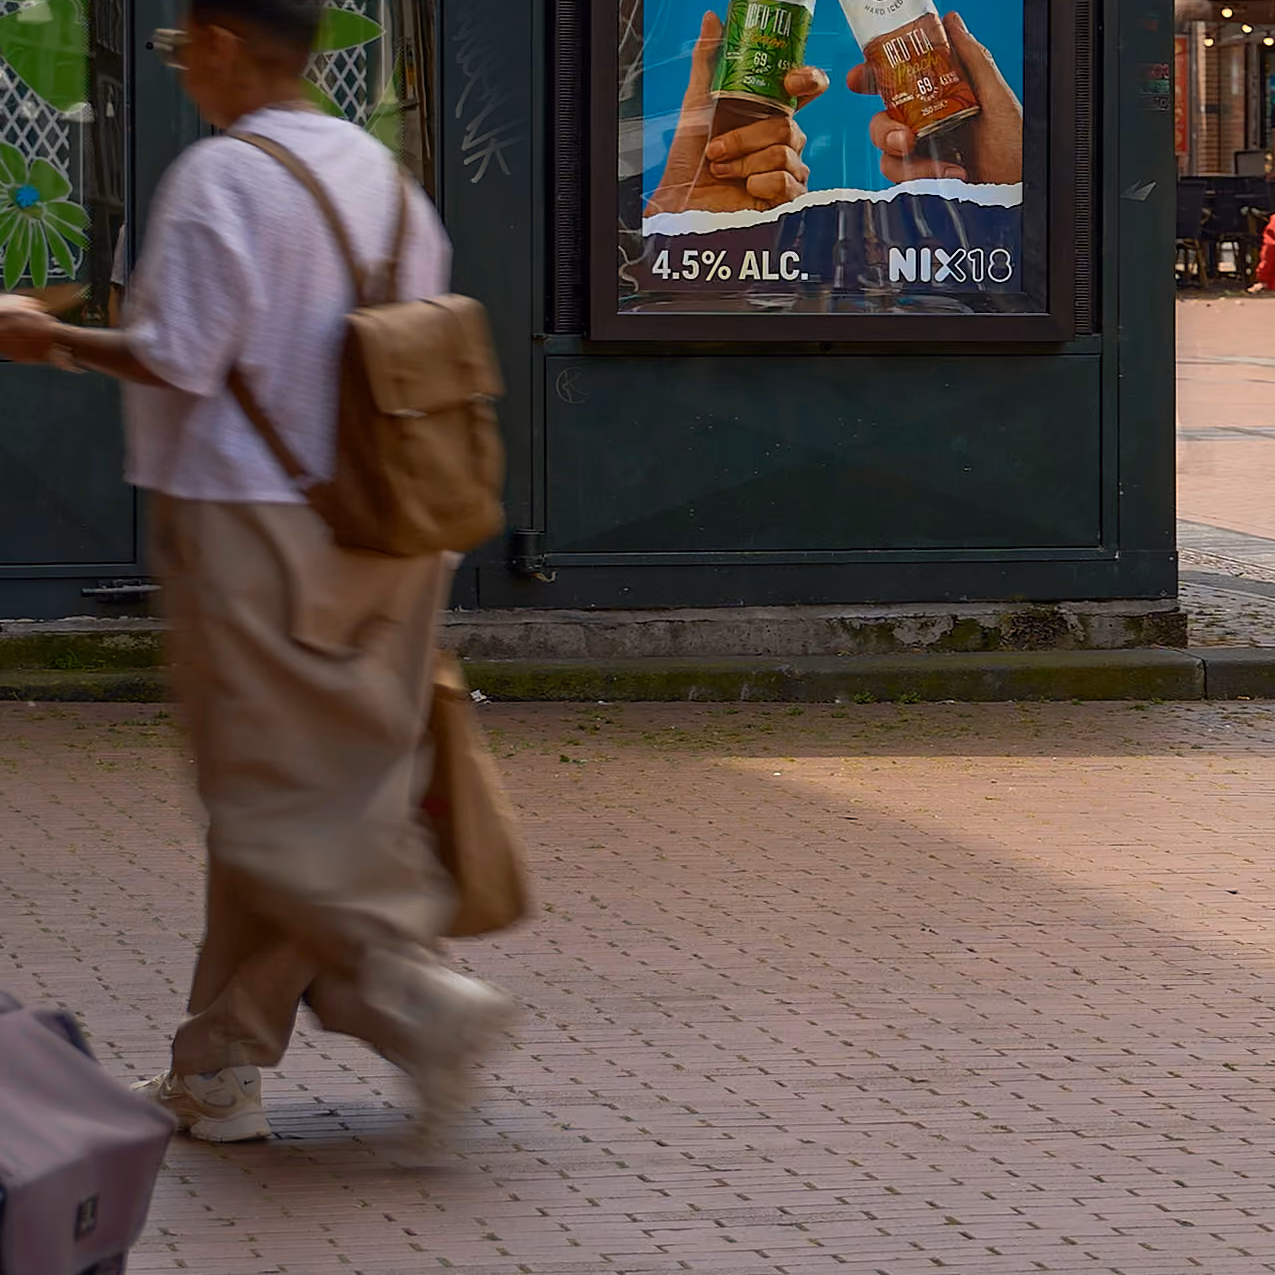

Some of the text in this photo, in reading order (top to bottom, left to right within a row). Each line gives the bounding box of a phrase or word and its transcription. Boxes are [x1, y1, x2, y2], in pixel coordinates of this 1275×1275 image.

[772, 7, 792, 37] TEA
[754, 51, 768, 67] 69
[882, 27, 934, 69] ICED TEA
[916, 76, 934, 96] 69
[652, 250, 809, 281] 4.5% ALC.
[887, 246, 1014, 283] NIX18
